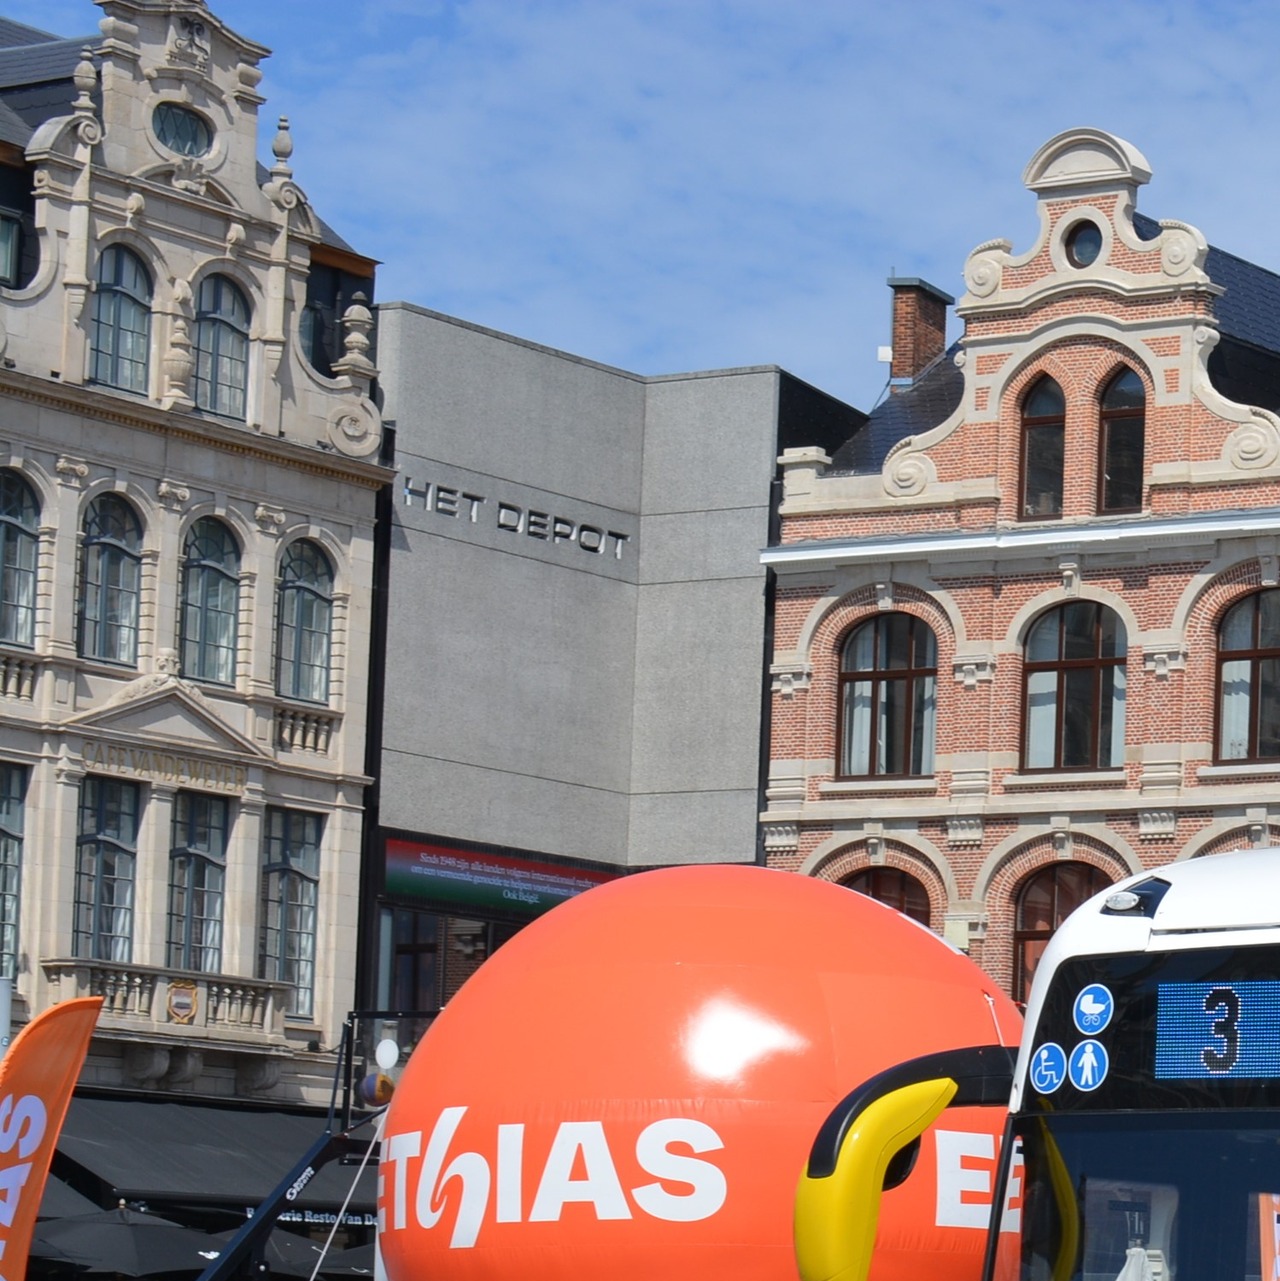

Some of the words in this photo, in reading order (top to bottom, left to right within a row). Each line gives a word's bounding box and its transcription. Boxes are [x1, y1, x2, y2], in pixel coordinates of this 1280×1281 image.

[404, 476, 487, 523] HET
[497, 500, 632, 560] DEPOT
[1200, 986, 1241, 1075] 3
[304, 1210, 337, 1224] Resto
